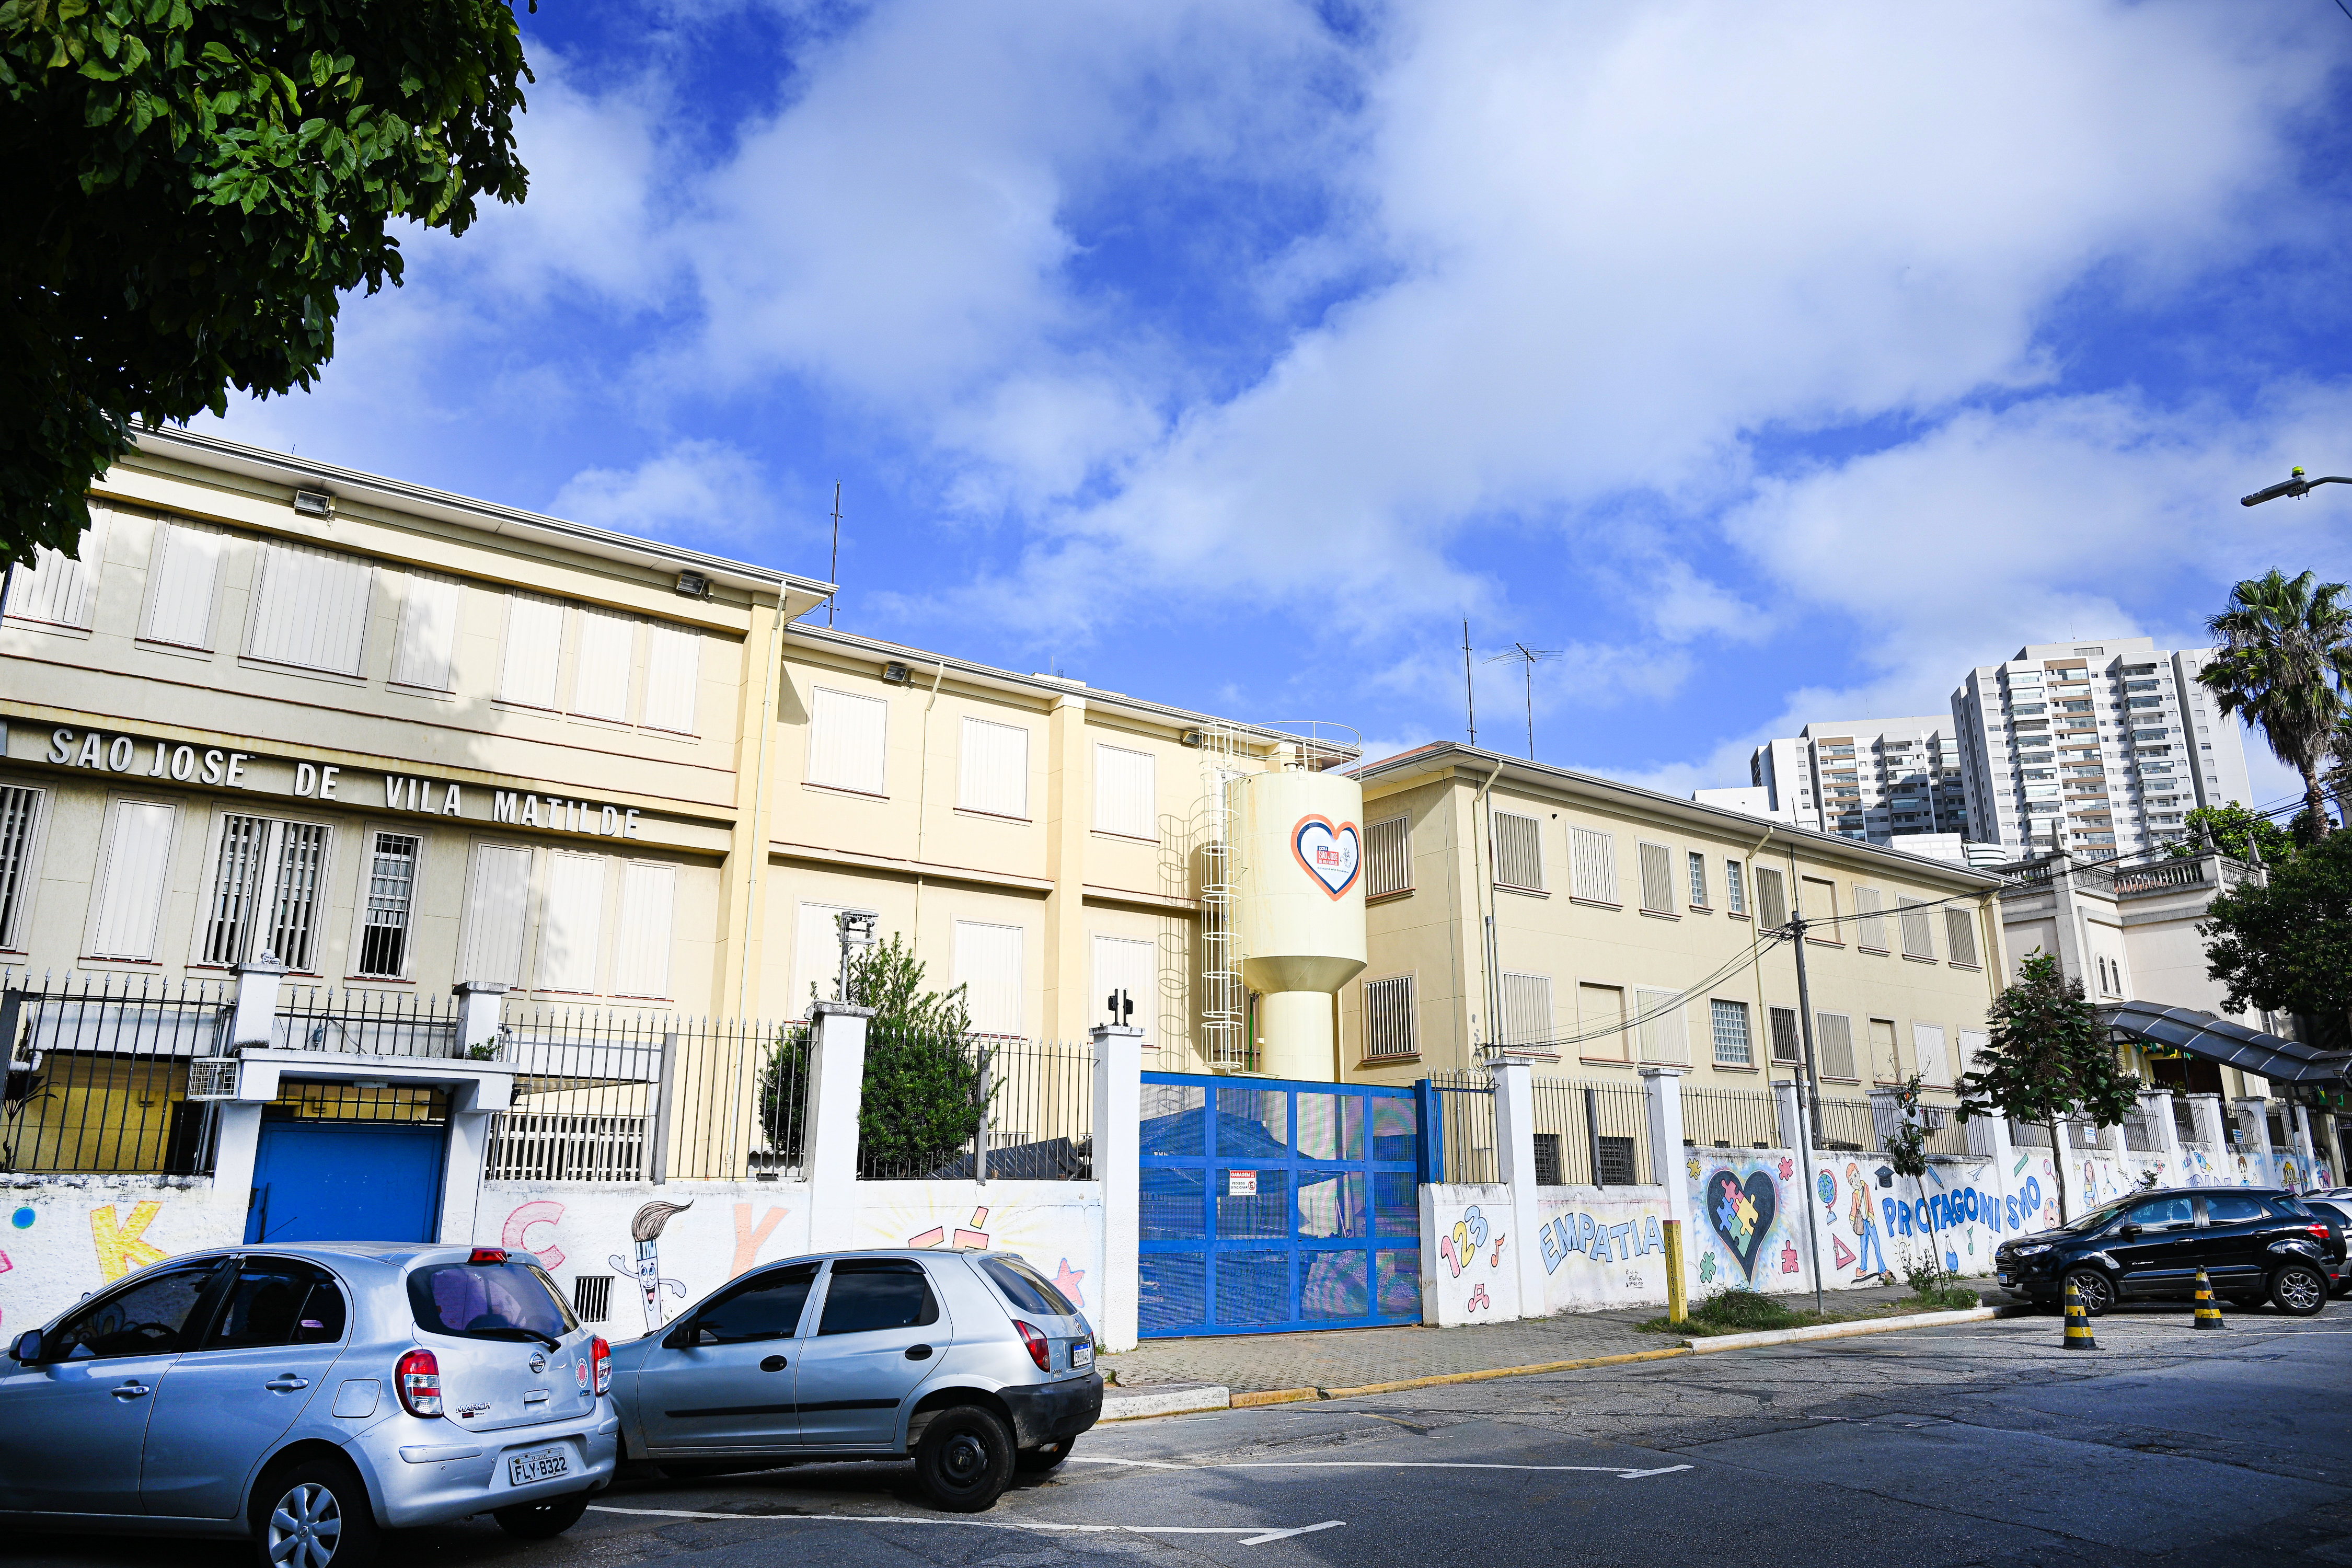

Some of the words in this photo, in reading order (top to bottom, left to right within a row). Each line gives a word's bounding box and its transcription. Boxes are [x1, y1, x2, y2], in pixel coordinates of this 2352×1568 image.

[294, 762, 340, 800] DE
[386, 775, 461, 816] VILA
[493, 790, 640, 839] MATILDE
[502, 1201, 566, 1271] C
[1882, 1175, 2040, 1238] PROTAGONISMO
[90, 1201, 173, 1286] K
[729, 1203, 790, 1281] Y
[1540, 1212, 1666, 1275] EMPATIA
[456, 1401, 491, 1413] MARCH
